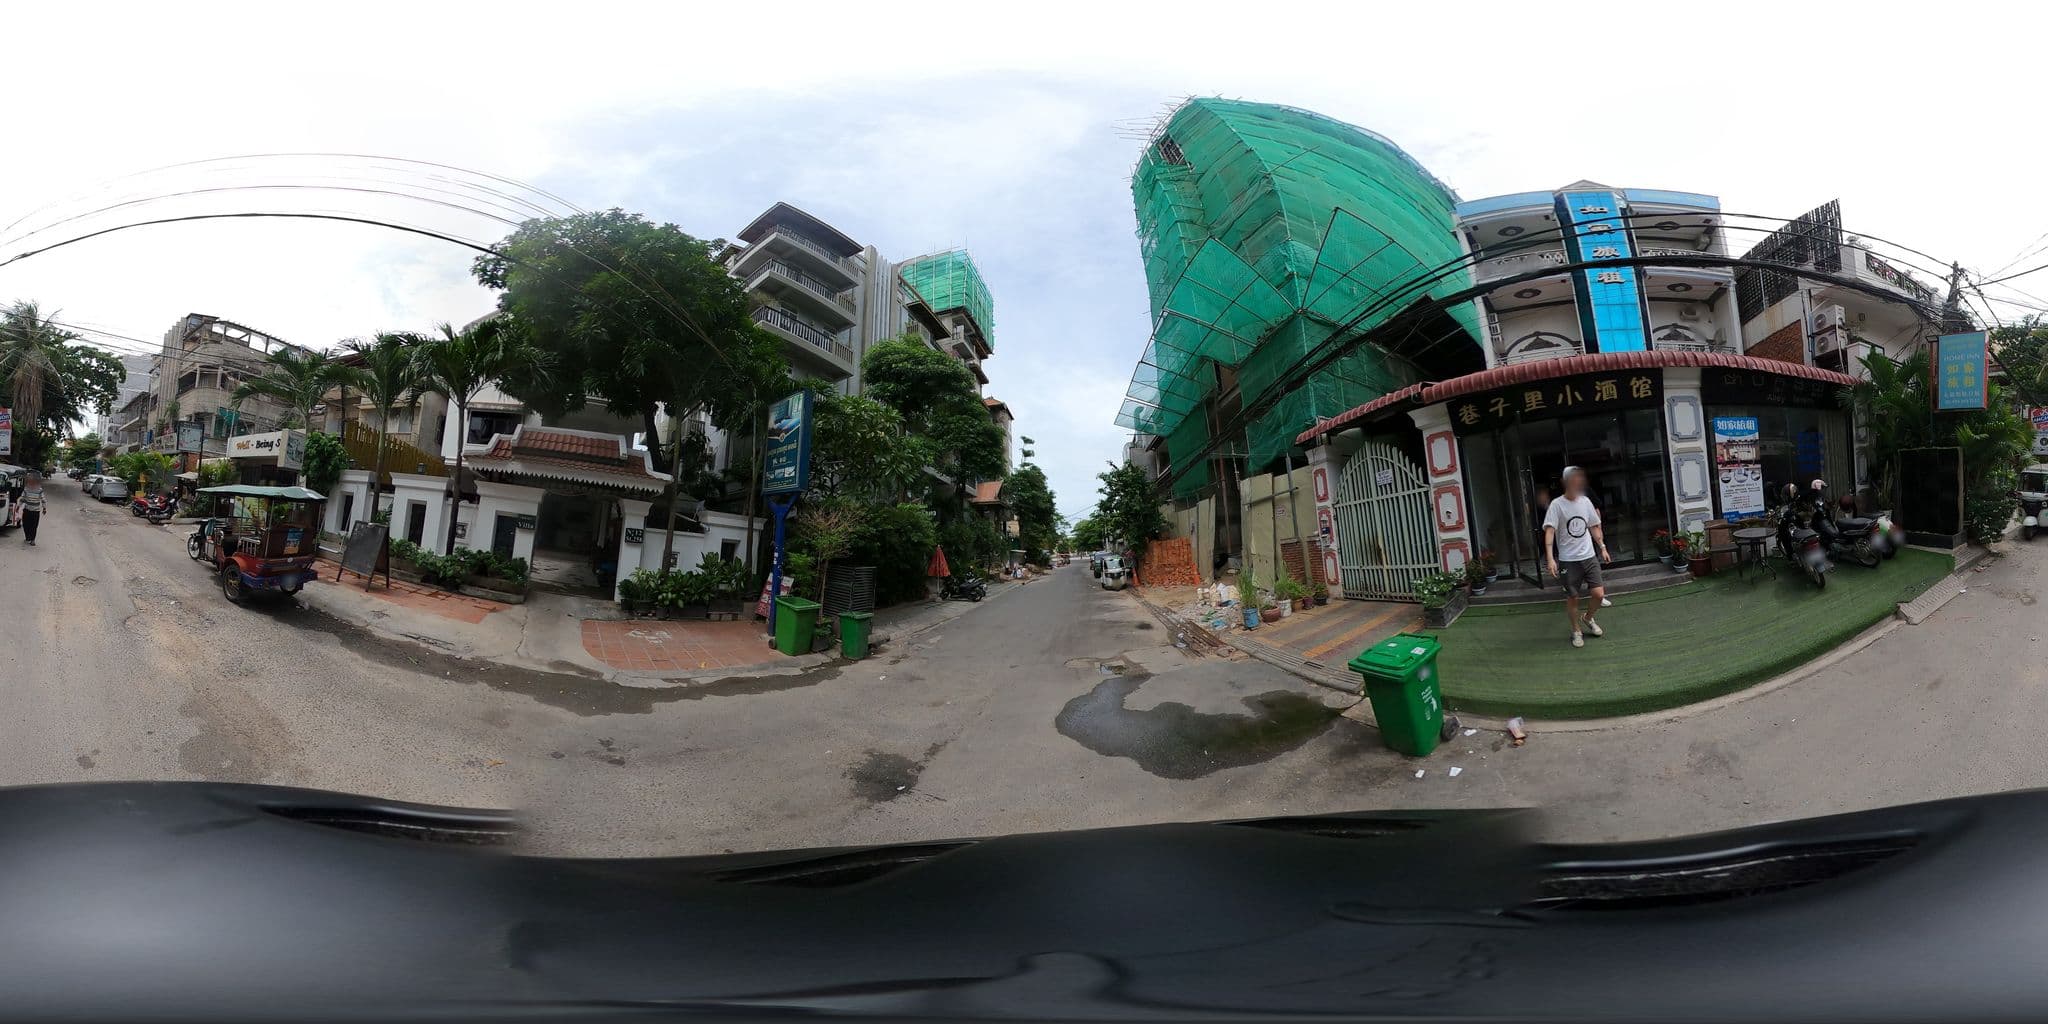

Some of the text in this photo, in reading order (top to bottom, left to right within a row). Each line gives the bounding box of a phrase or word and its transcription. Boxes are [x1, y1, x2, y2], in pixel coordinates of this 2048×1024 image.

[1459, 376, 1653, 425] 巷子里小酒馆
[256, 439, 274, 451] Being
